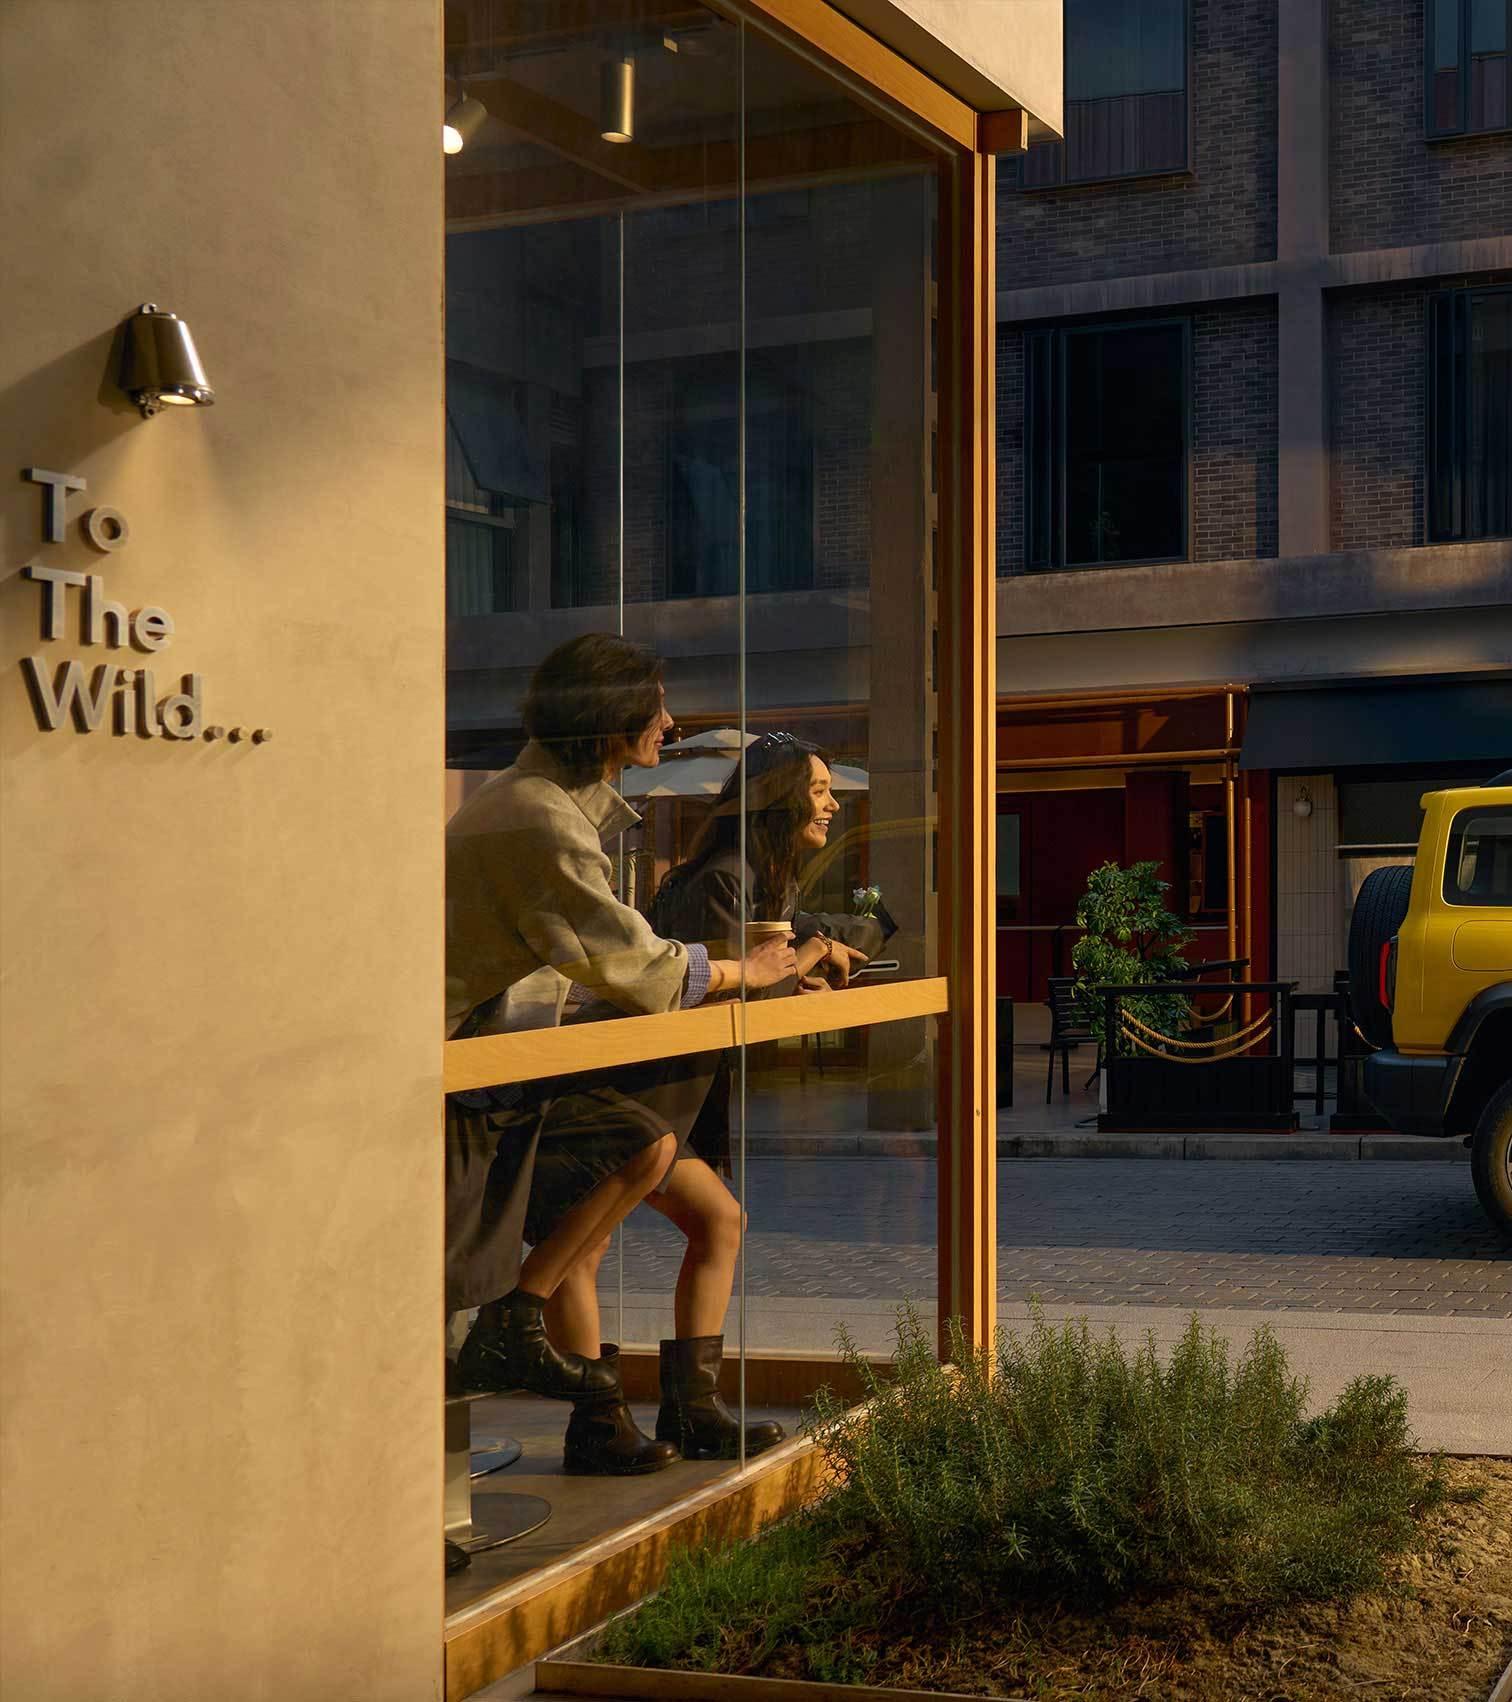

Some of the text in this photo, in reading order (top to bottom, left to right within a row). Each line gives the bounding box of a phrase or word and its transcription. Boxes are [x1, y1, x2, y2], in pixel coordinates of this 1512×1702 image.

[23, 467, 128, 552] To
[22, 566, 175, 653] The
[20, 656, 273, 743] Wild...
